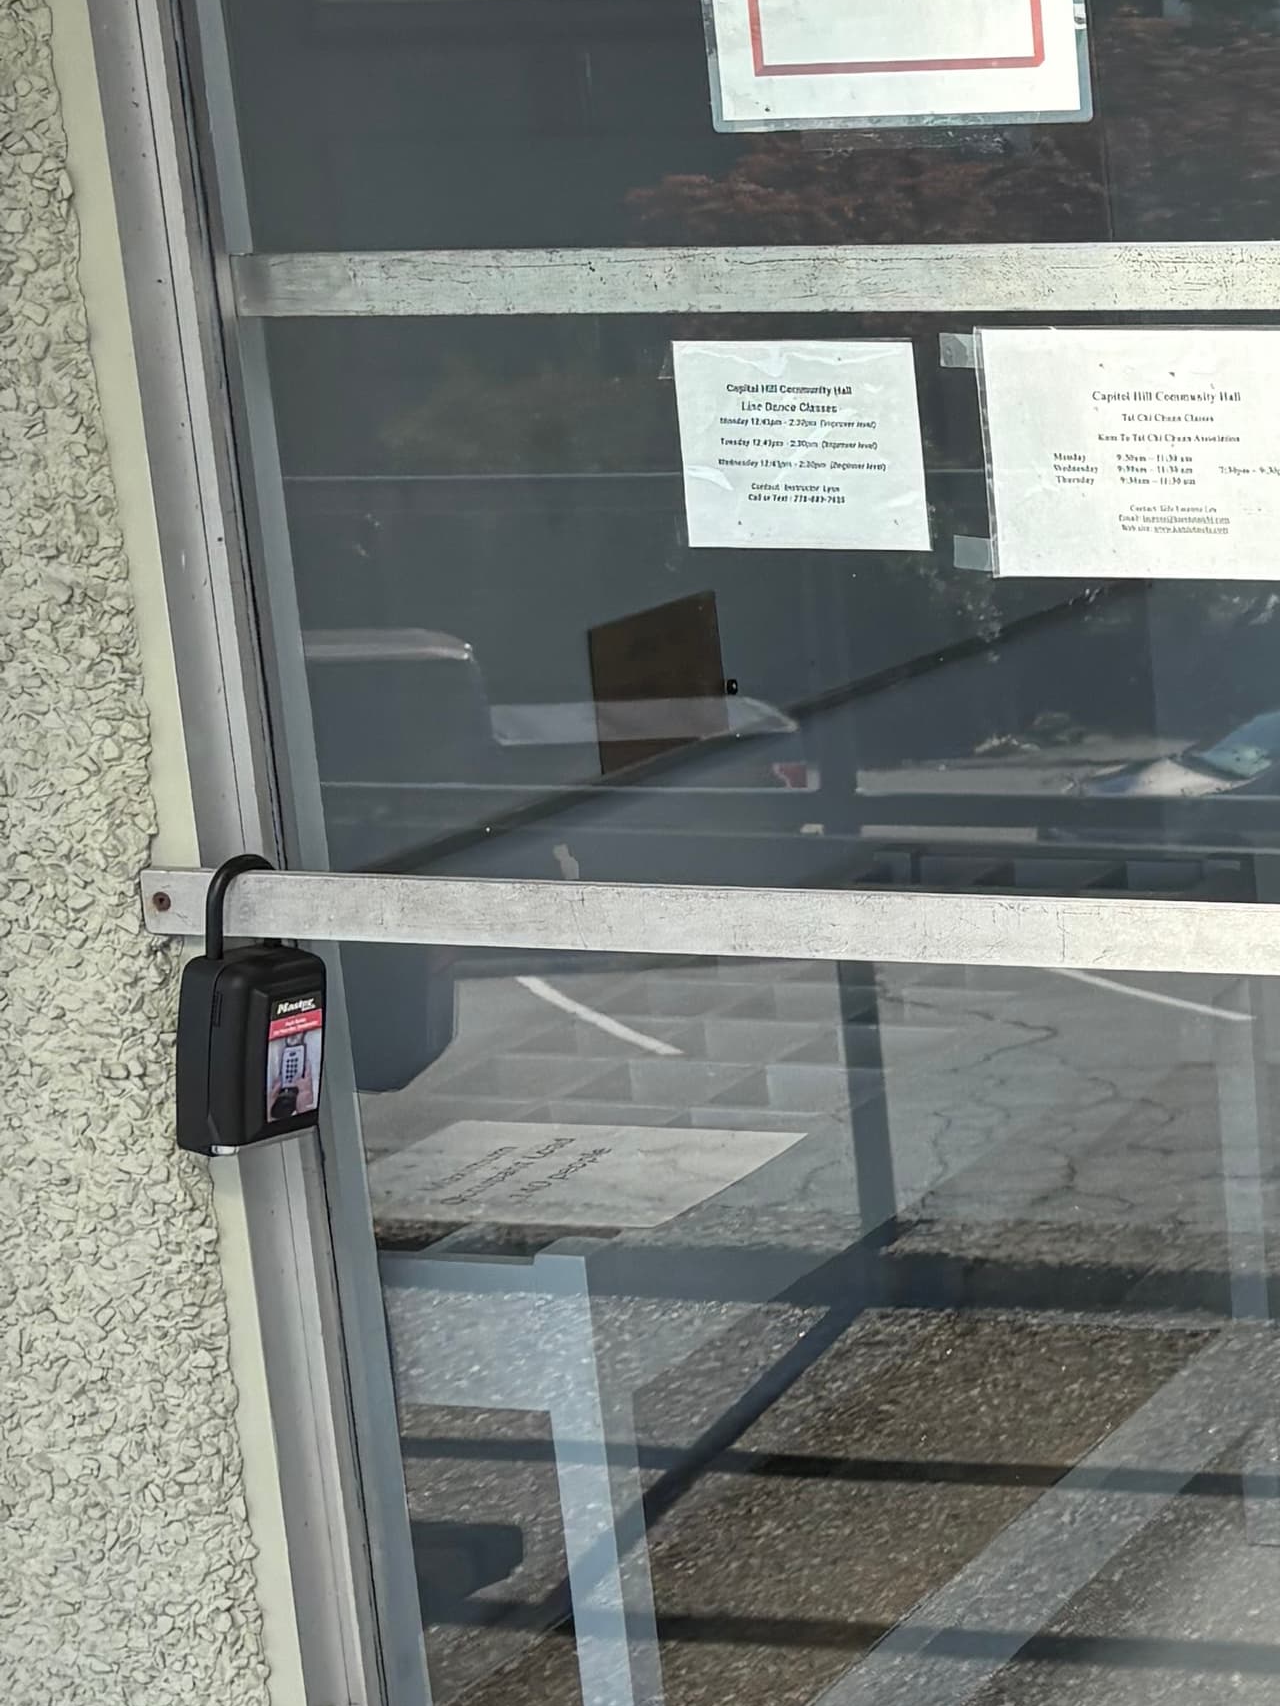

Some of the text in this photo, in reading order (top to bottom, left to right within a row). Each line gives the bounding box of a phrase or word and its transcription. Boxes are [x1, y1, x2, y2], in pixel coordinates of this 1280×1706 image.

[779, 385, 831, 397] Community
[1133, 391, 1153, 401] Hill
[1155, 391, 1215, 404] Community
[1219, 391, 1241, 402] Hall
[741, 400, 838, 413] Line Dance Classes
